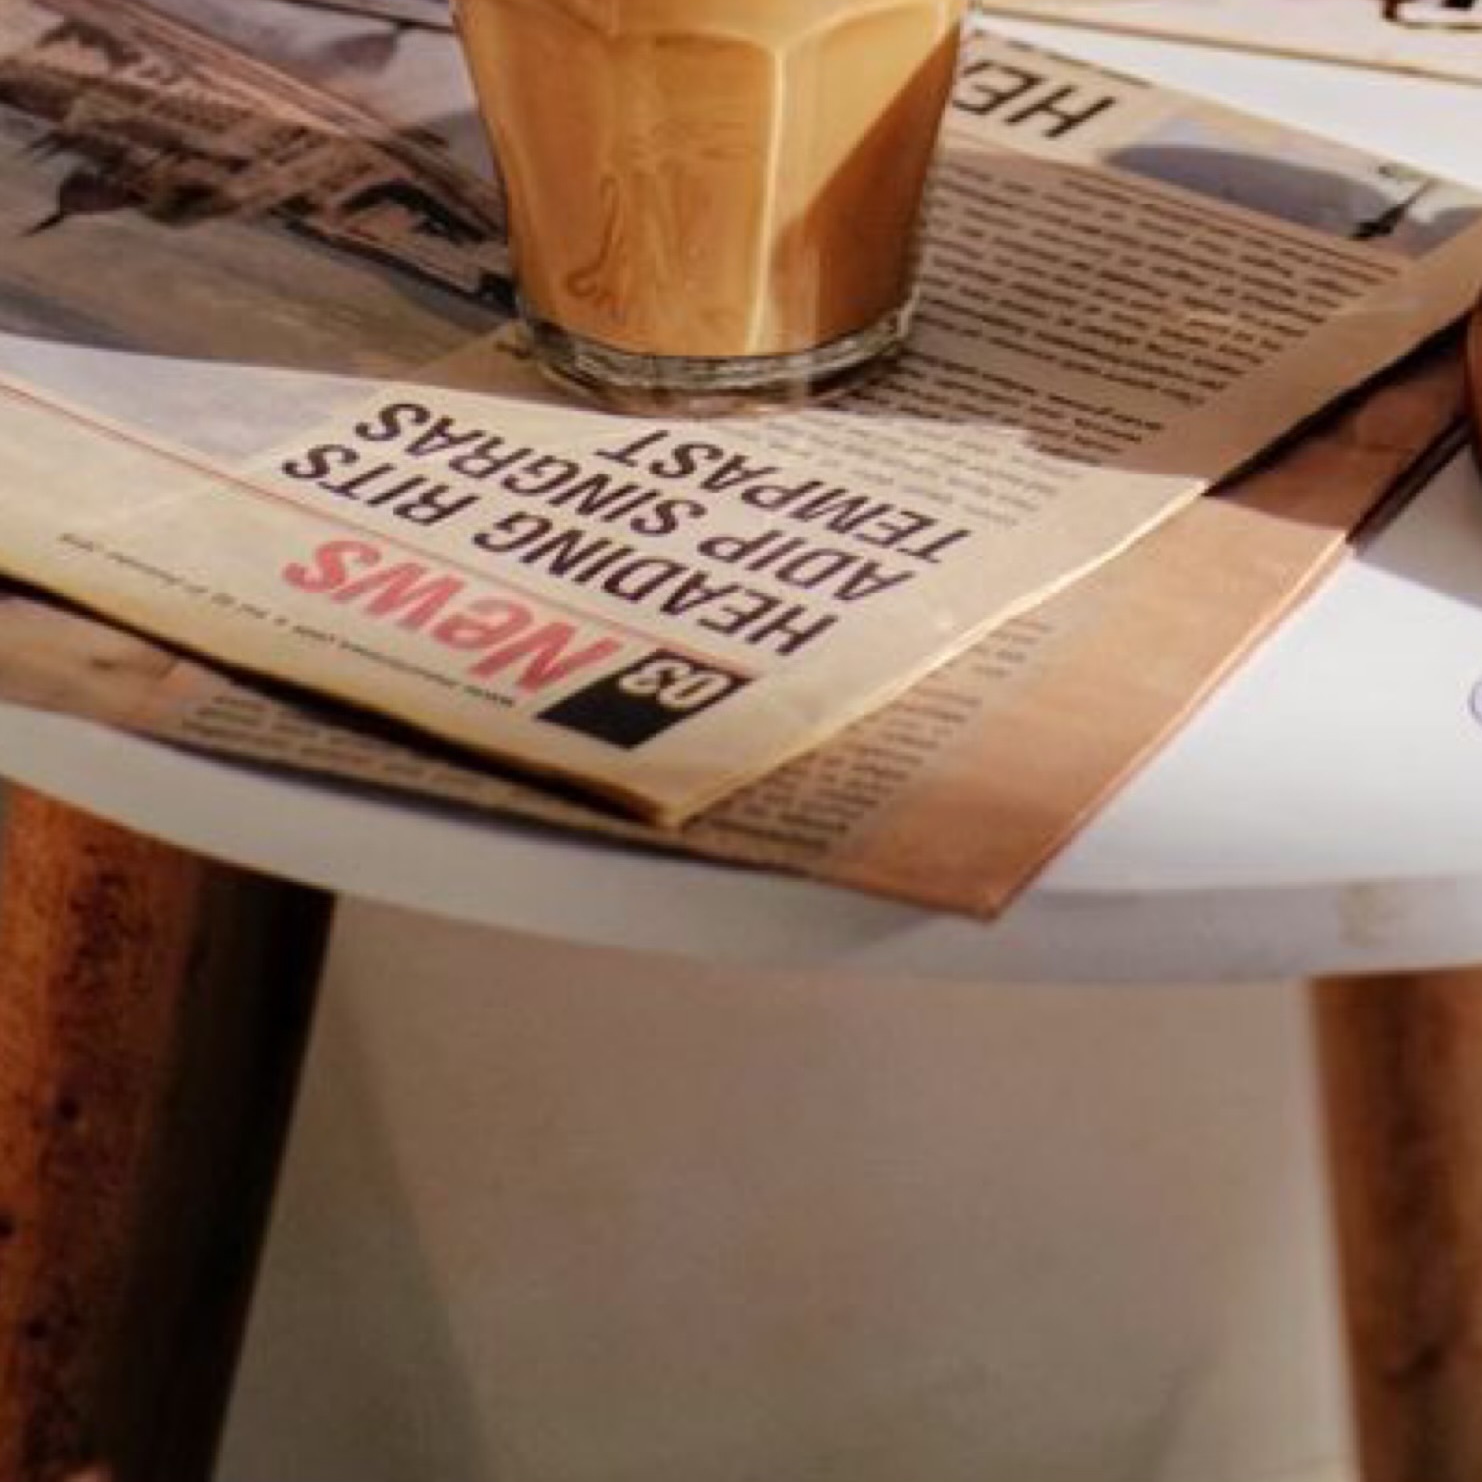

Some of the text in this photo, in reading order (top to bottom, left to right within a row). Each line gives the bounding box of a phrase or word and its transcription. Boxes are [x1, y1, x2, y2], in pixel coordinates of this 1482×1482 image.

[951, 58, 1117, 139] HE
[281, 442, 482, 528] RITS
[355, 401, 706, 528] SINGRAS
[599, 429, 972, 566] TEMPAST
[282, 539, 625, 696] News
[473, 523, 840, 657] HEADING
[696, 531, 917, 601] ADIP
